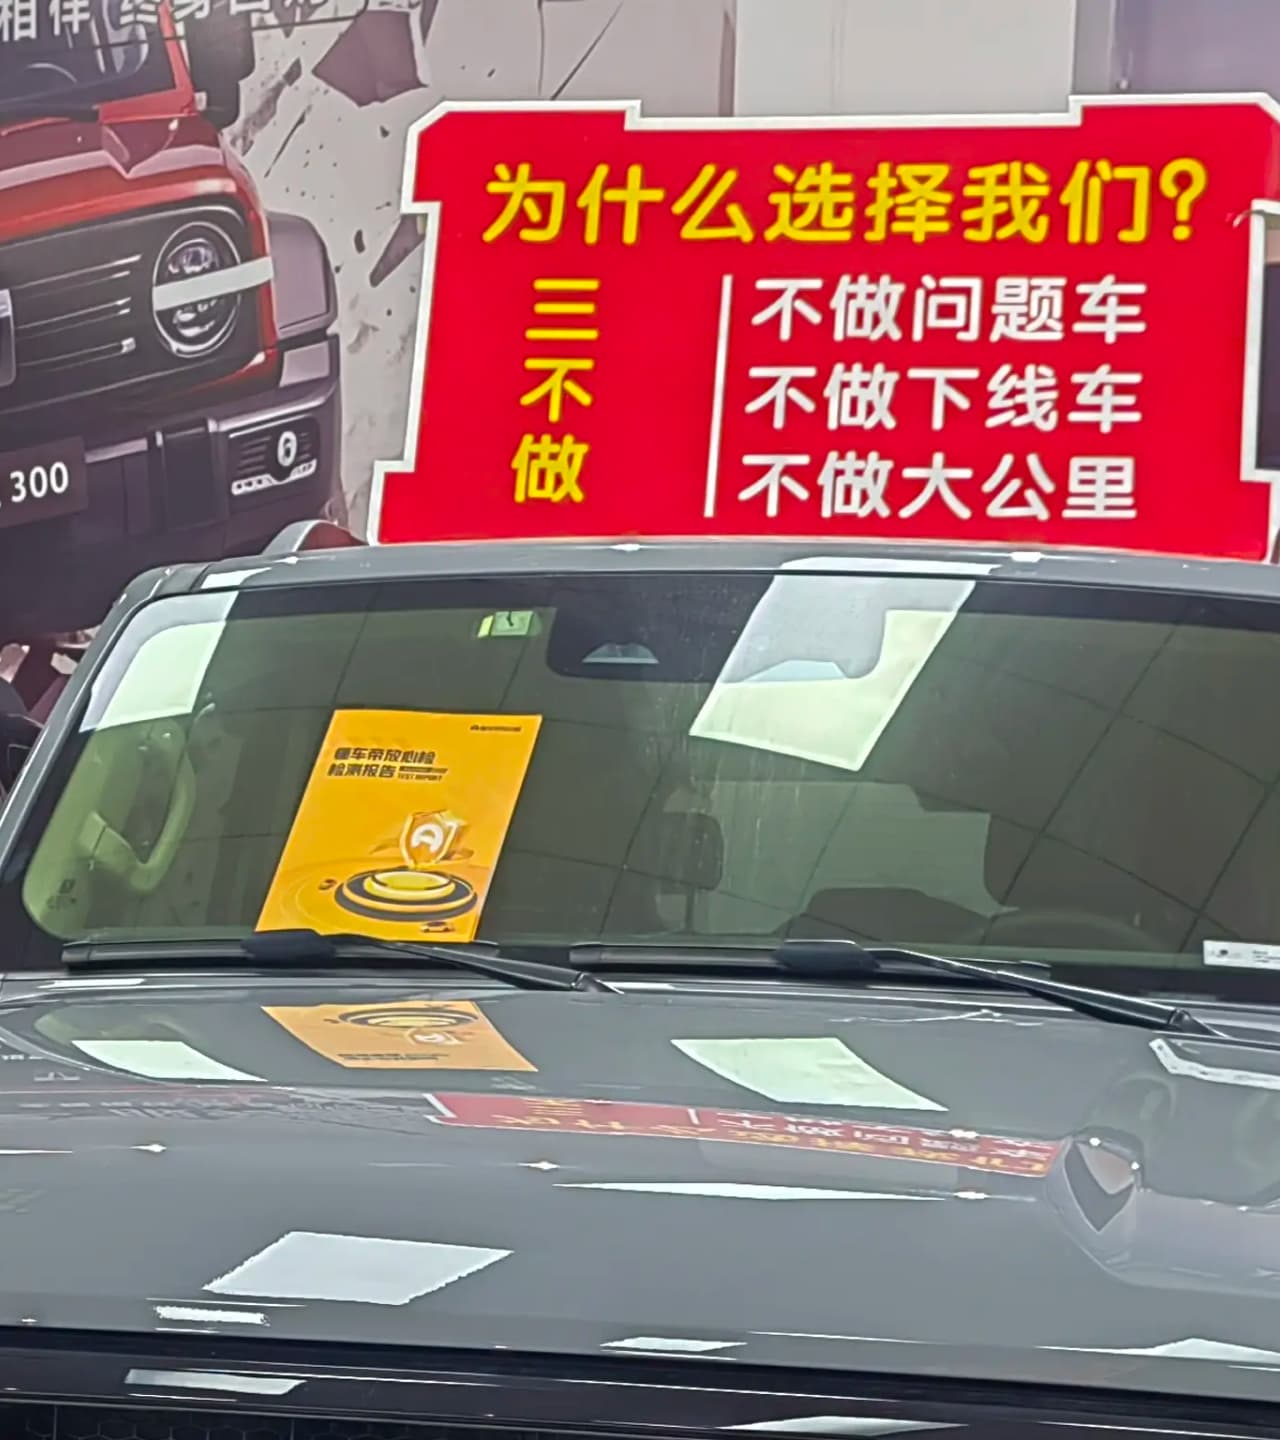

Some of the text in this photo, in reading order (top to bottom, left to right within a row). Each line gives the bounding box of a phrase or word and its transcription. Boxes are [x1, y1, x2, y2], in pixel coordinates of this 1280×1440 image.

[482, 157, 1210, 247] 为什么选择我们?
[750, 273, 1149, 344] 不做问题车
[510, 277, 600, 504] 三不做
[744, 363, 1144, 434] 不做下线车
[10, 461, 69, 503] 300
[737, 451, 1139, 521] 不做大公里
